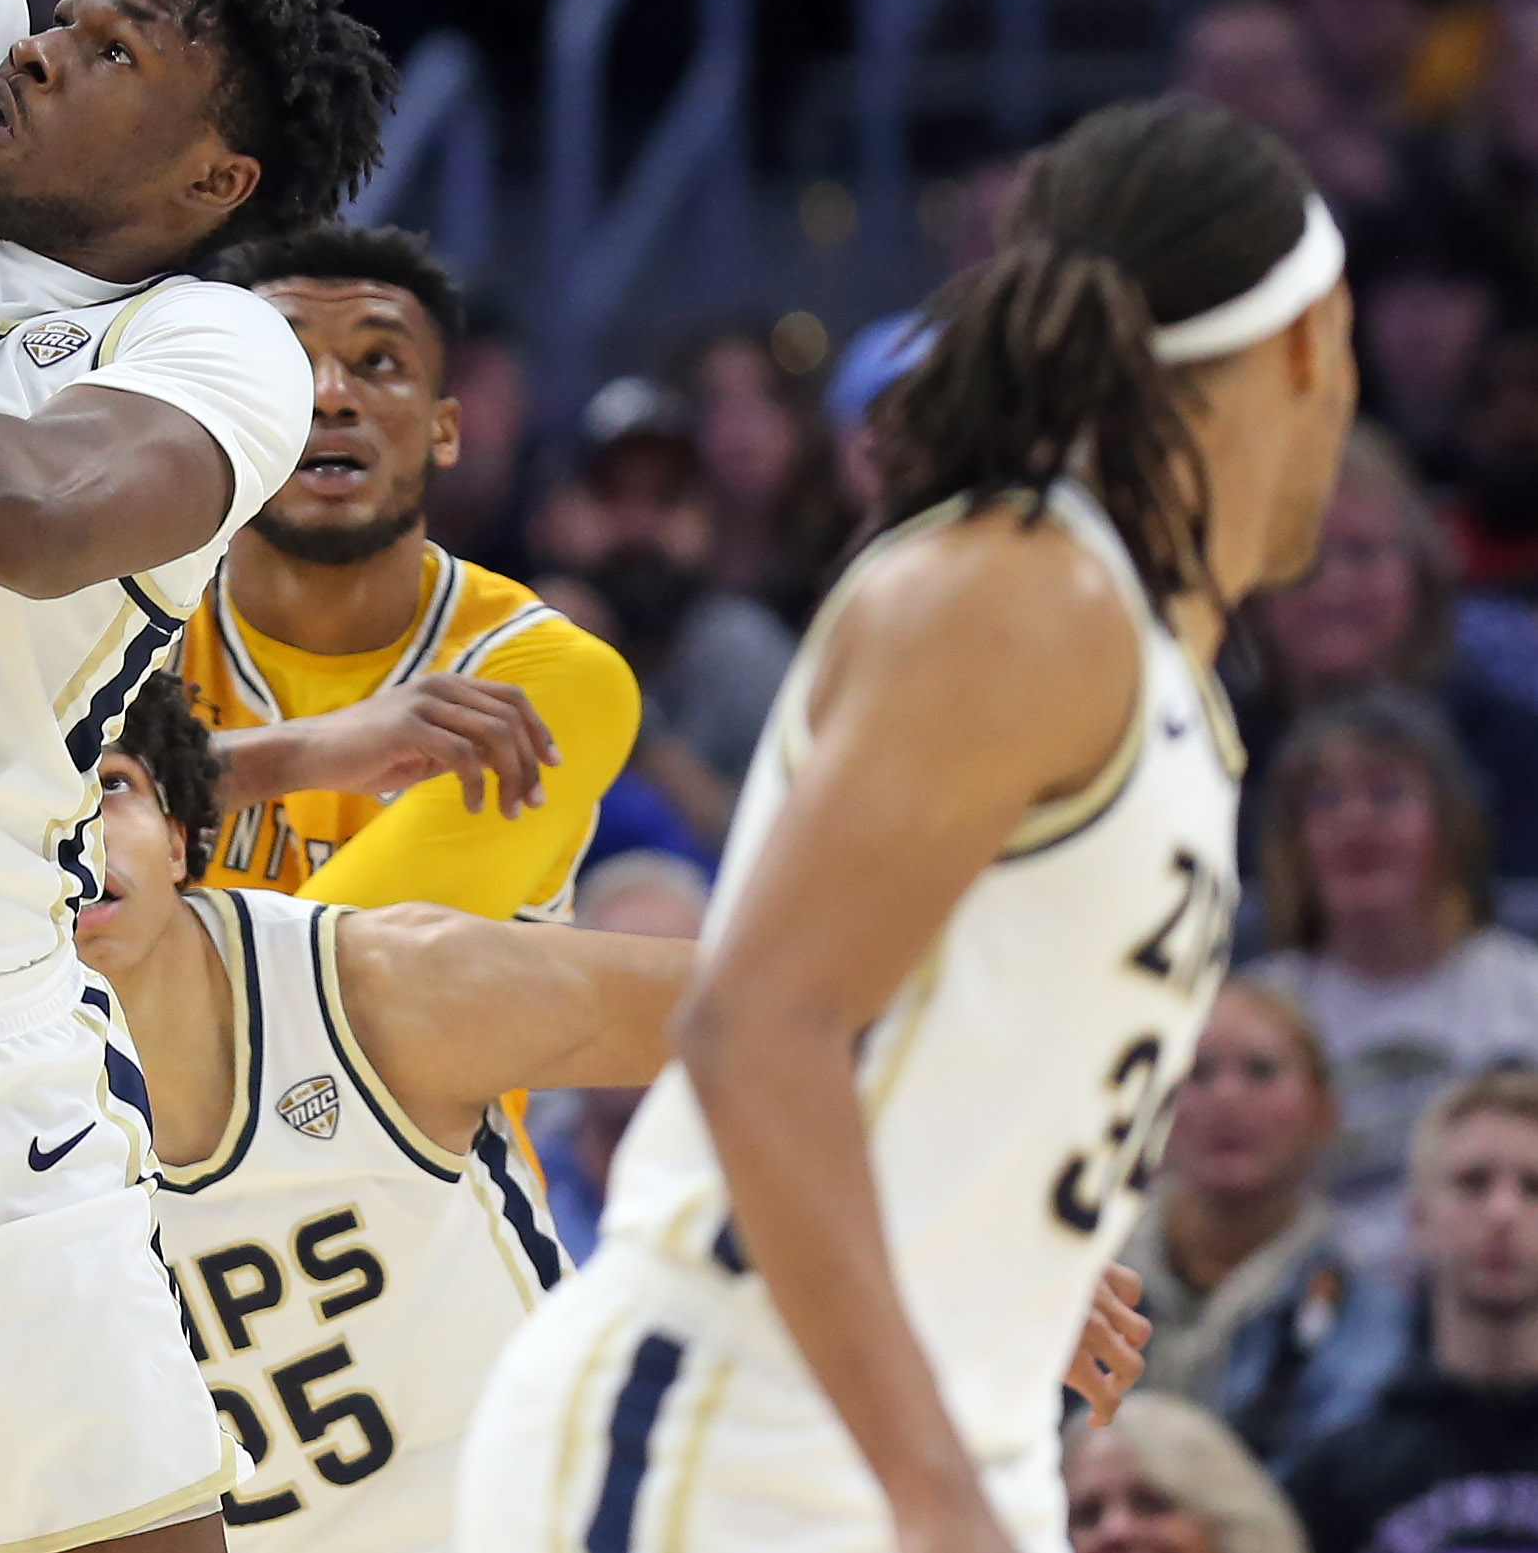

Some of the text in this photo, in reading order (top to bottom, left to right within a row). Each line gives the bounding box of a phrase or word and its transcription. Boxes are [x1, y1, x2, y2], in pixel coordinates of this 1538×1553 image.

[22, 332, 81, 351] MAC
[285, 1088, 339, 1127] MAC
[210, 1334, 399, 1527] 25
